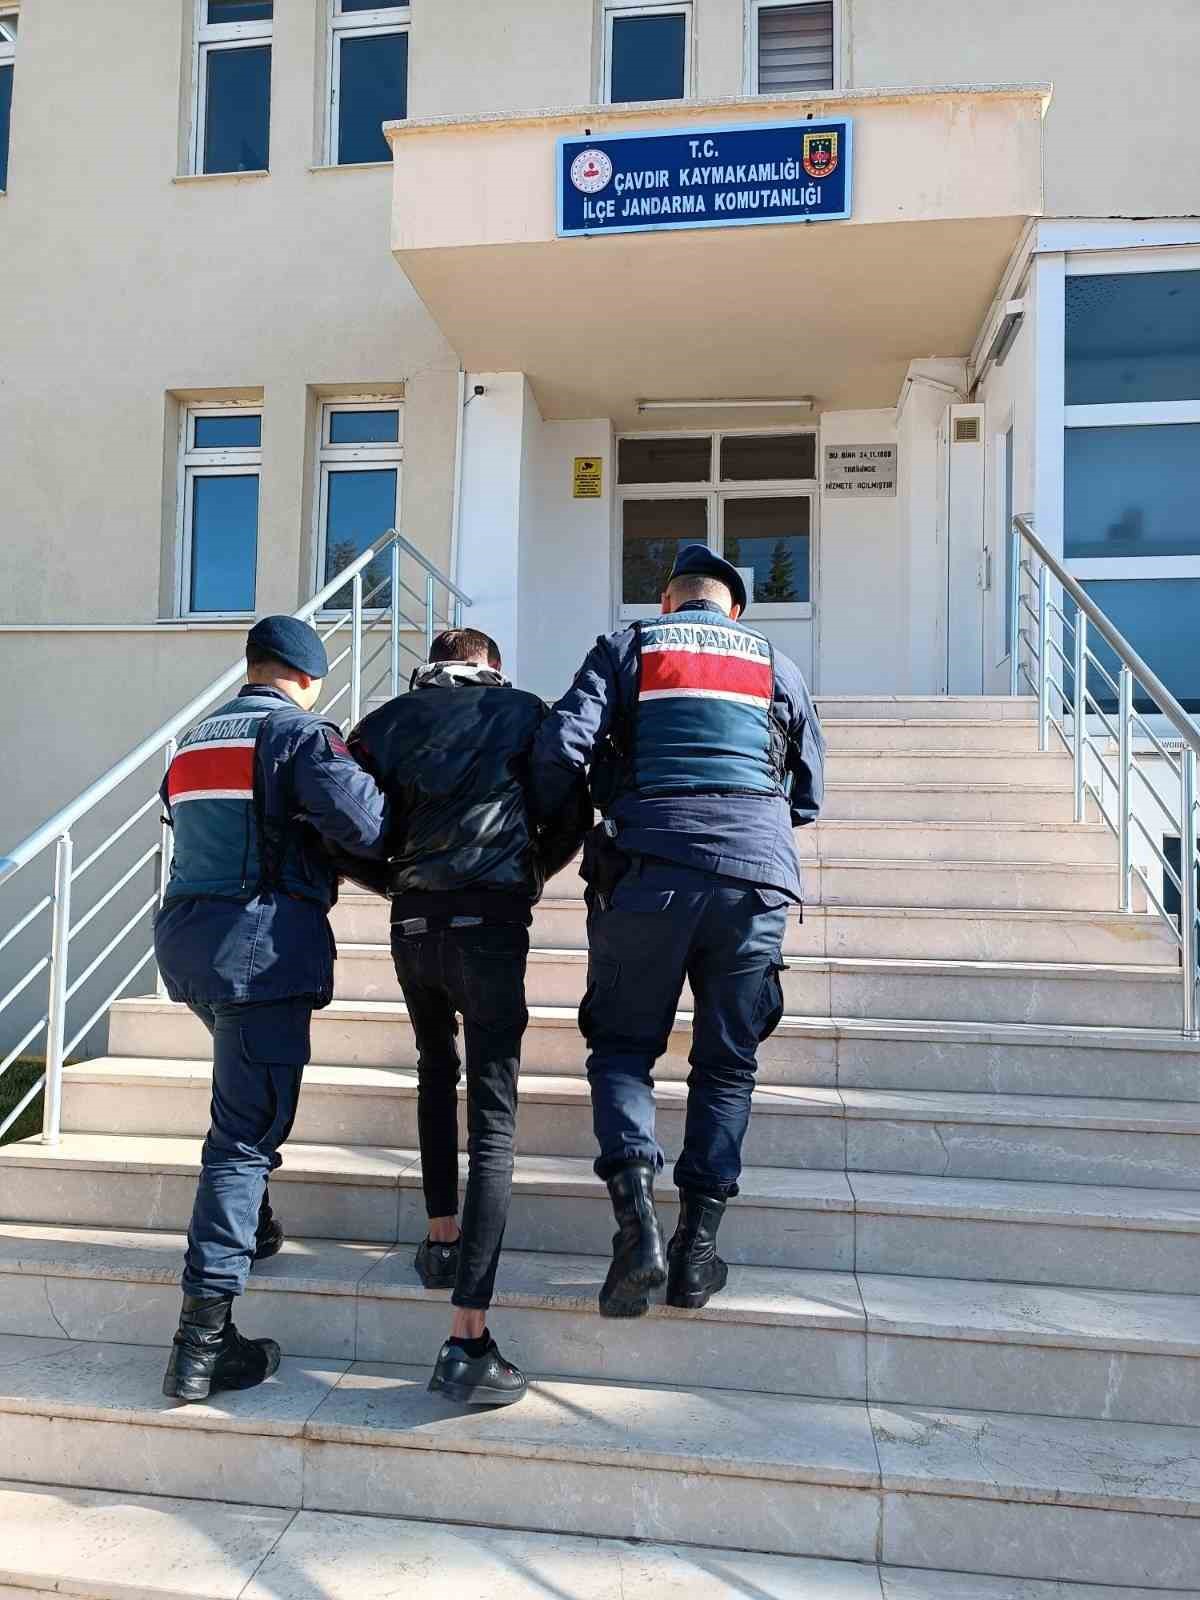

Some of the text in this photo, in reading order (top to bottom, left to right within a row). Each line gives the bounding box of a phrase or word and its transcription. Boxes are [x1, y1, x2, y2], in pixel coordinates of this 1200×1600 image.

[689, 140, 719, 158] T.C.
[614, 158, 800, 195] ÇAVDIR KAYMAKAMLIĞI
[583, 182, 822, 223] İLÇE JANDARMA KOMUTANLIĞI
[655, 627, 760, 655] JANDARMA
